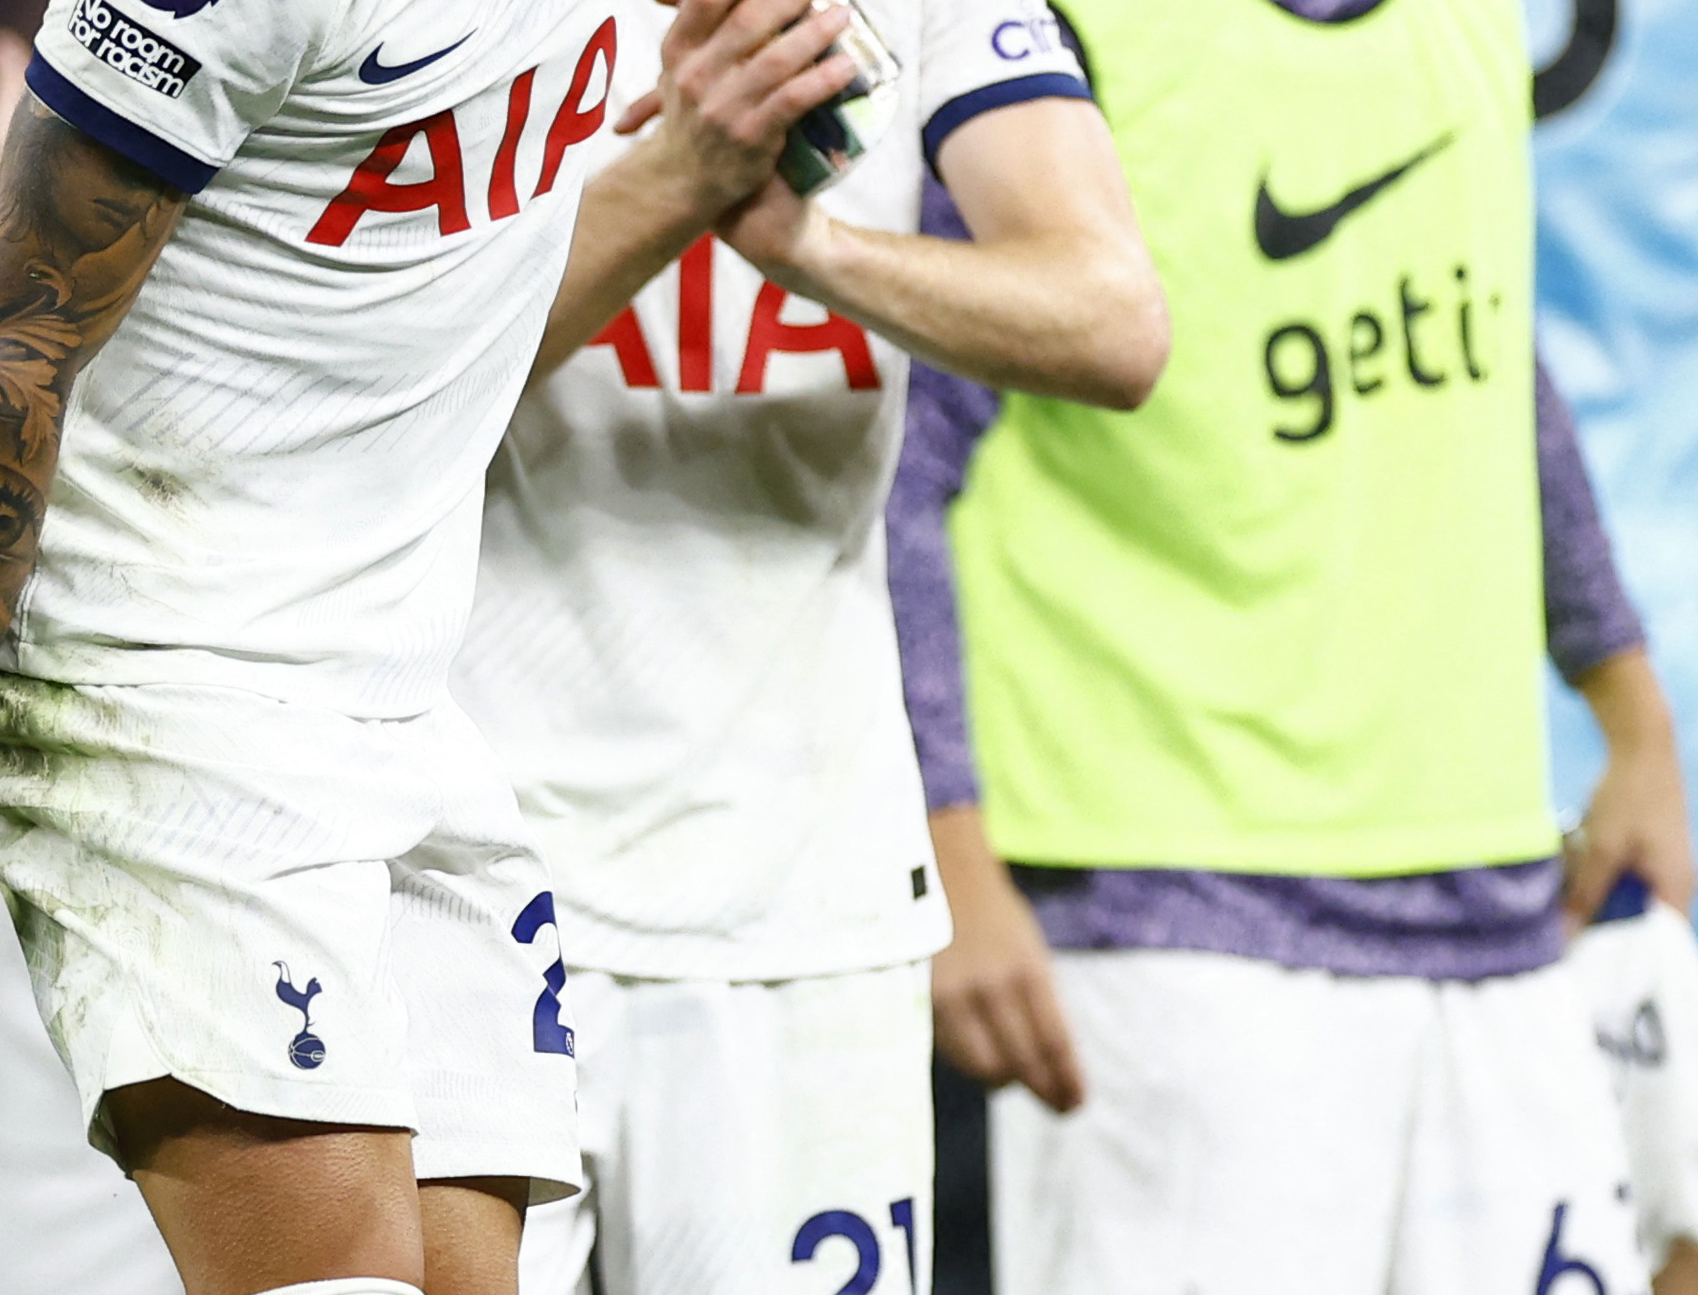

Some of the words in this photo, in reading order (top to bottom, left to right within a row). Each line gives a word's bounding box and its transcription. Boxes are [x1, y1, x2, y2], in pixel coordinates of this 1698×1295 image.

[67, 8, 102, 48] for
[95, 37, 185, 99] racism
[109, 18, 186, 75] room
[304, 15, 618, 248] AIA
